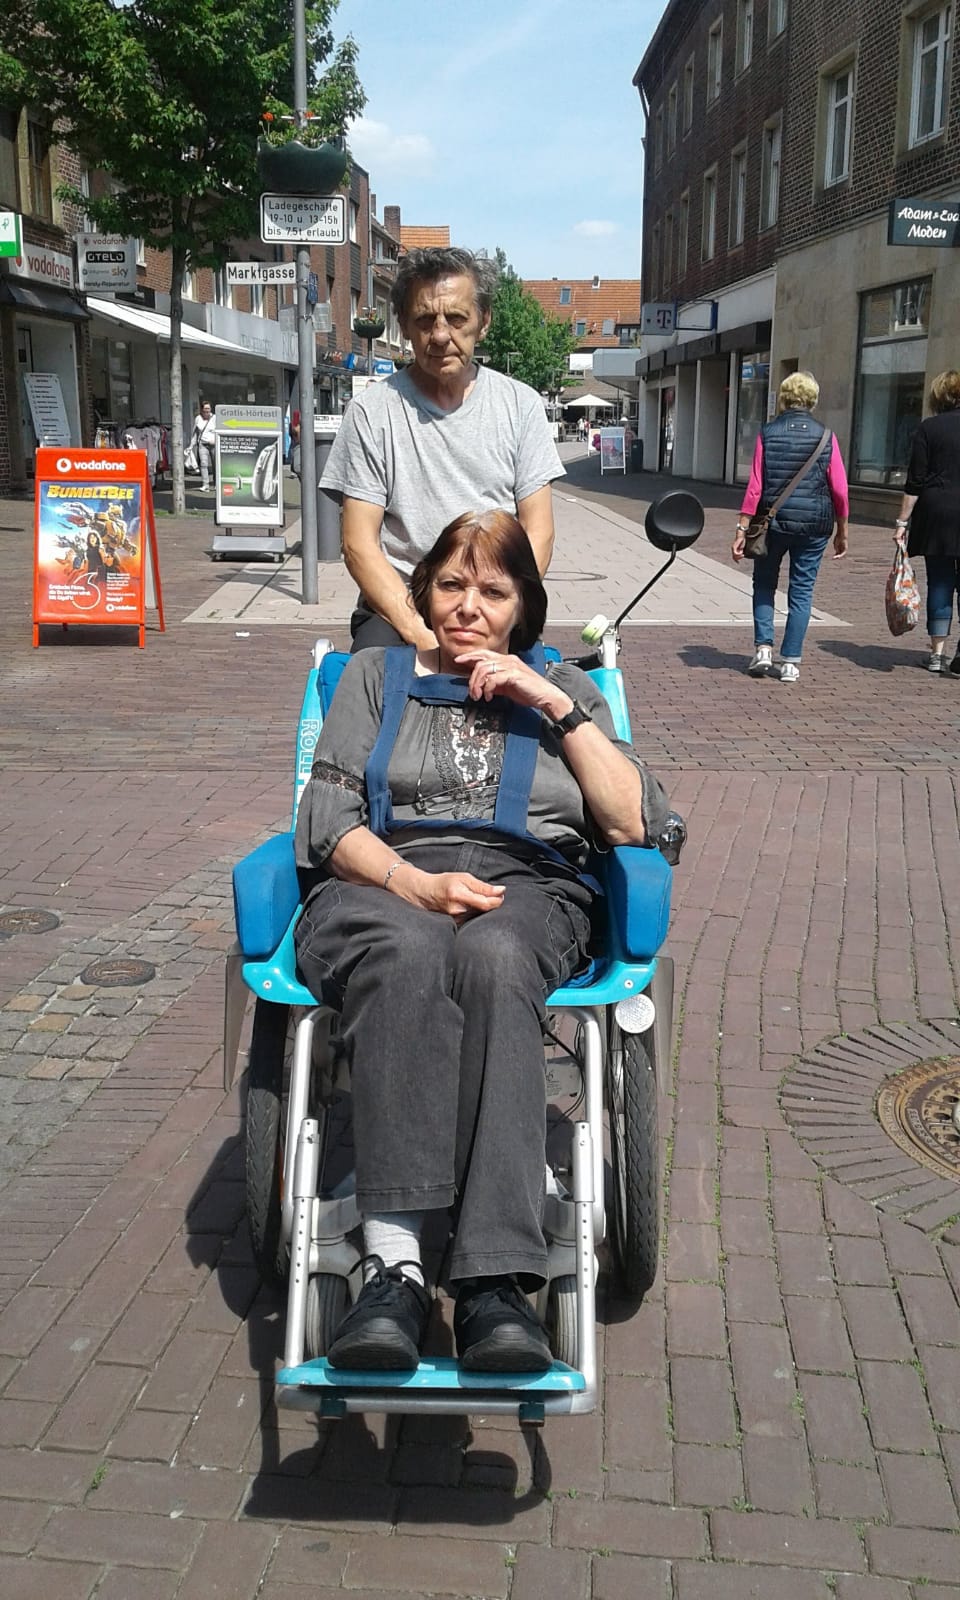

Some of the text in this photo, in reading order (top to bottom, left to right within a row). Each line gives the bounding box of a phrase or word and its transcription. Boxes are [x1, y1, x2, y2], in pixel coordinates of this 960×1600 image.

[897, 206, 932, 220] Adam
[940, 210, 960, 222] Eva
[267, 226, 282, 235] bis
[306, 228, 340, 237] erlaubt
[907, 224, 947, 238] Moden
[28, 255, 70, 280] vodafone
[112, 266, 128, 278] sky
[228, 266, 295, 281] Marktgasse
[74, 460, 126, 471] vodafone
